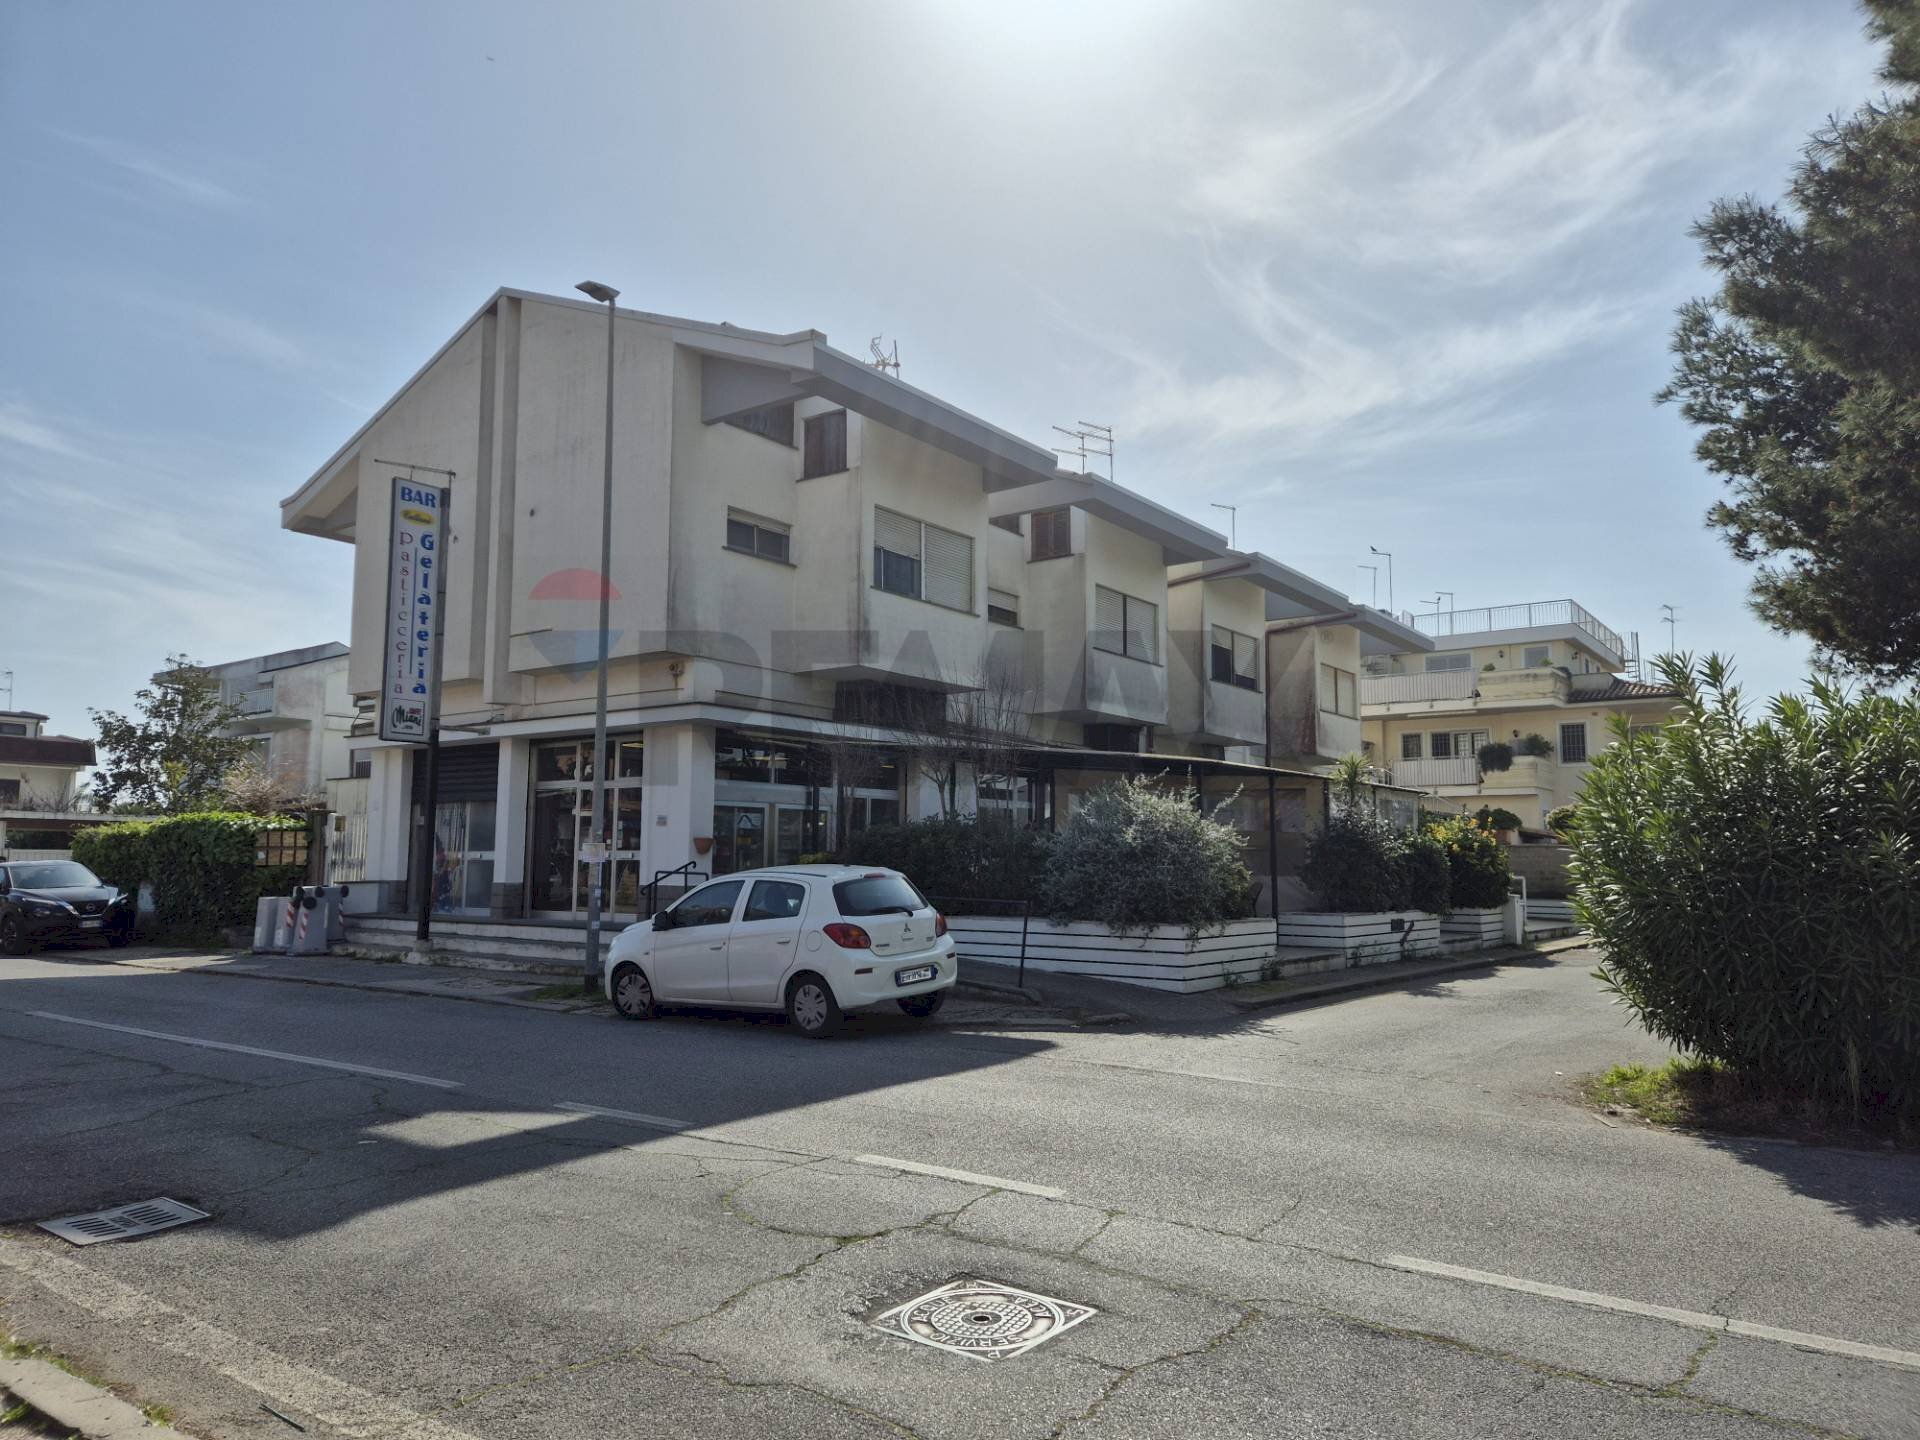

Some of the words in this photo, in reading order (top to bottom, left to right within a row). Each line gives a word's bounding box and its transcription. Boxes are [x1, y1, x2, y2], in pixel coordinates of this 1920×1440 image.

[401, 486, 436, 508] BAR
[394, 531, 413, 694] Pasticceria
[412, 533, 435, 694] Gelateria
[930, 1332, 1023, 1347] SERVIZIO
